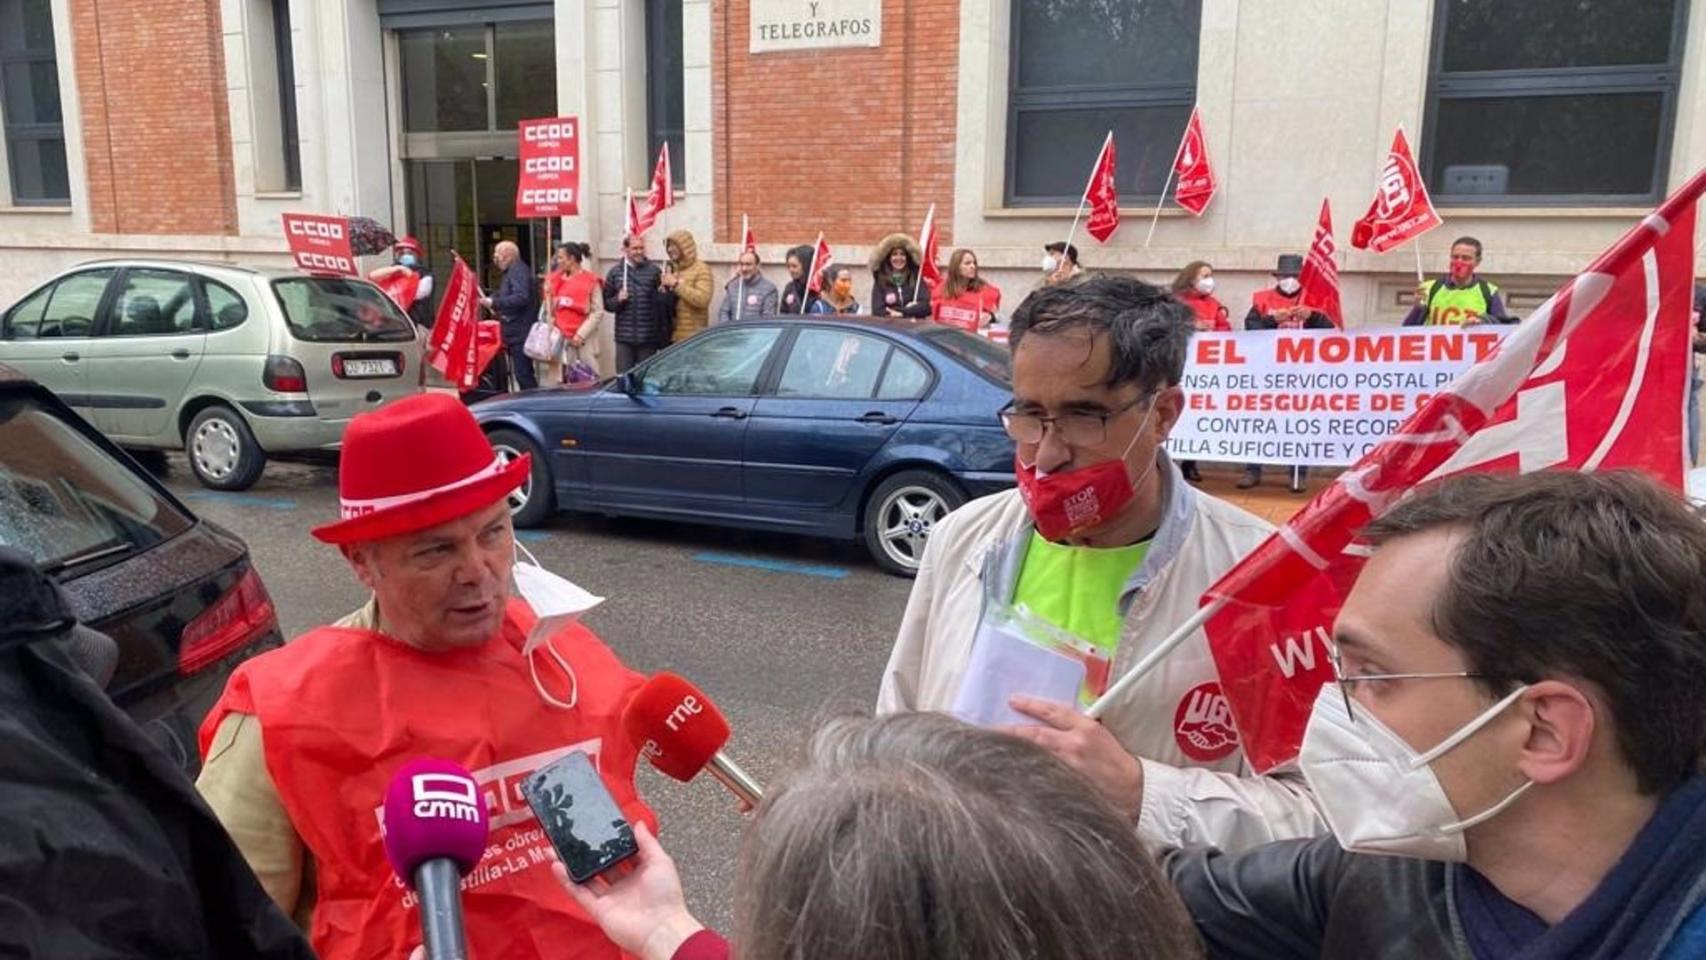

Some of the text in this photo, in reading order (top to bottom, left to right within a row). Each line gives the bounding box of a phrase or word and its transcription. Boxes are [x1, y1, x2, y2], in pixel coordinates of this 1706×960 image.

[810, 2, 818, 17] Y
[758, 19, 871, 39] TELEGRAFOS
[525, 123, 574, 141] CCOO
[526, 156, 574, 173] CCOO
[522, 188, 572, 204] CCOO
[289, 220, 344, 239] CCOO
[298, 252, 351, 271] CCOO
[1196, 339, 1246, 364] EL
[1227, 374, 1259, 389] DEL
[1263, 373, 1349, 389] SERVICIO
[1355, 373, 1428, 388] POSTAL
[1190, 394, 1218, 410] EL
[1227, 394, 1361, 411] DESGUACE
[1370, 394, 1405, 411] DE
[1197, 417, 1407, 436] CONTRA LOS RECOR
[1218, 440, 1335, 459] SUFICIENTE
[1342, 443, 1355, 459] Y
[665, 695, 703, 731] rne
[413, 799, 480, 823] cmm
